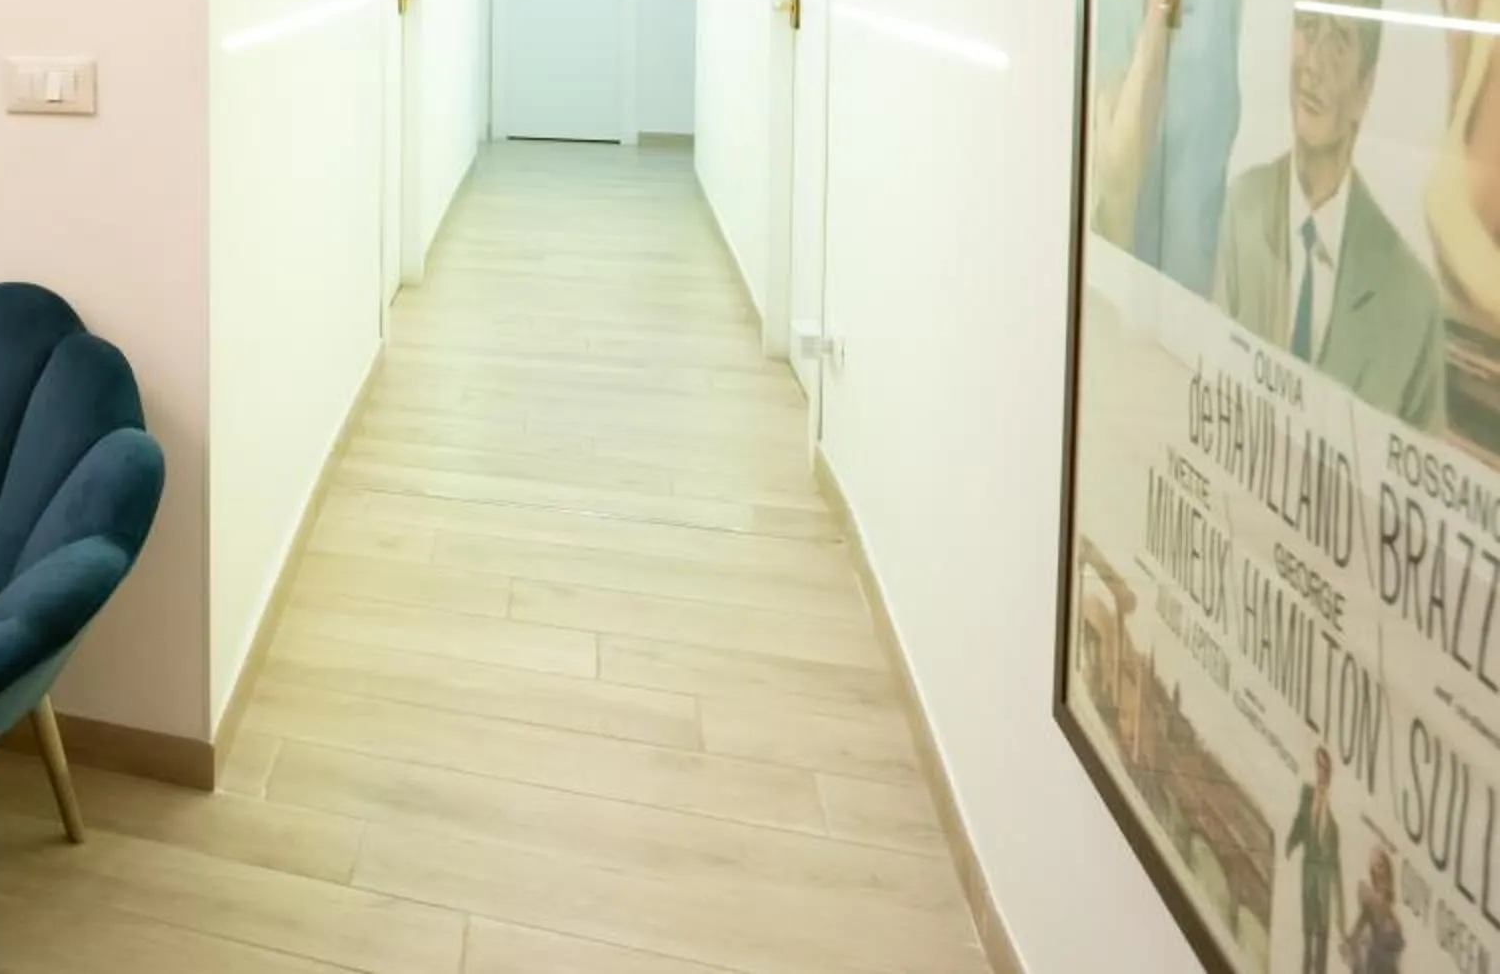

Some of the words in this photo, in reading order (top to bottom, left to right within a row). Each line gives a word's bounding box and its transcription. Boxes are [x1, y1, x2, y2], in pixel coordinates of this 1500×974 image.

[1254, 348, 1305, 413] OLIVIA
[1146, 464, 1231, 637] MIMIEUX
[1273, 539, 1348, 633] GEORGE
[1240, 557, 1383, 797] HAMILTON
